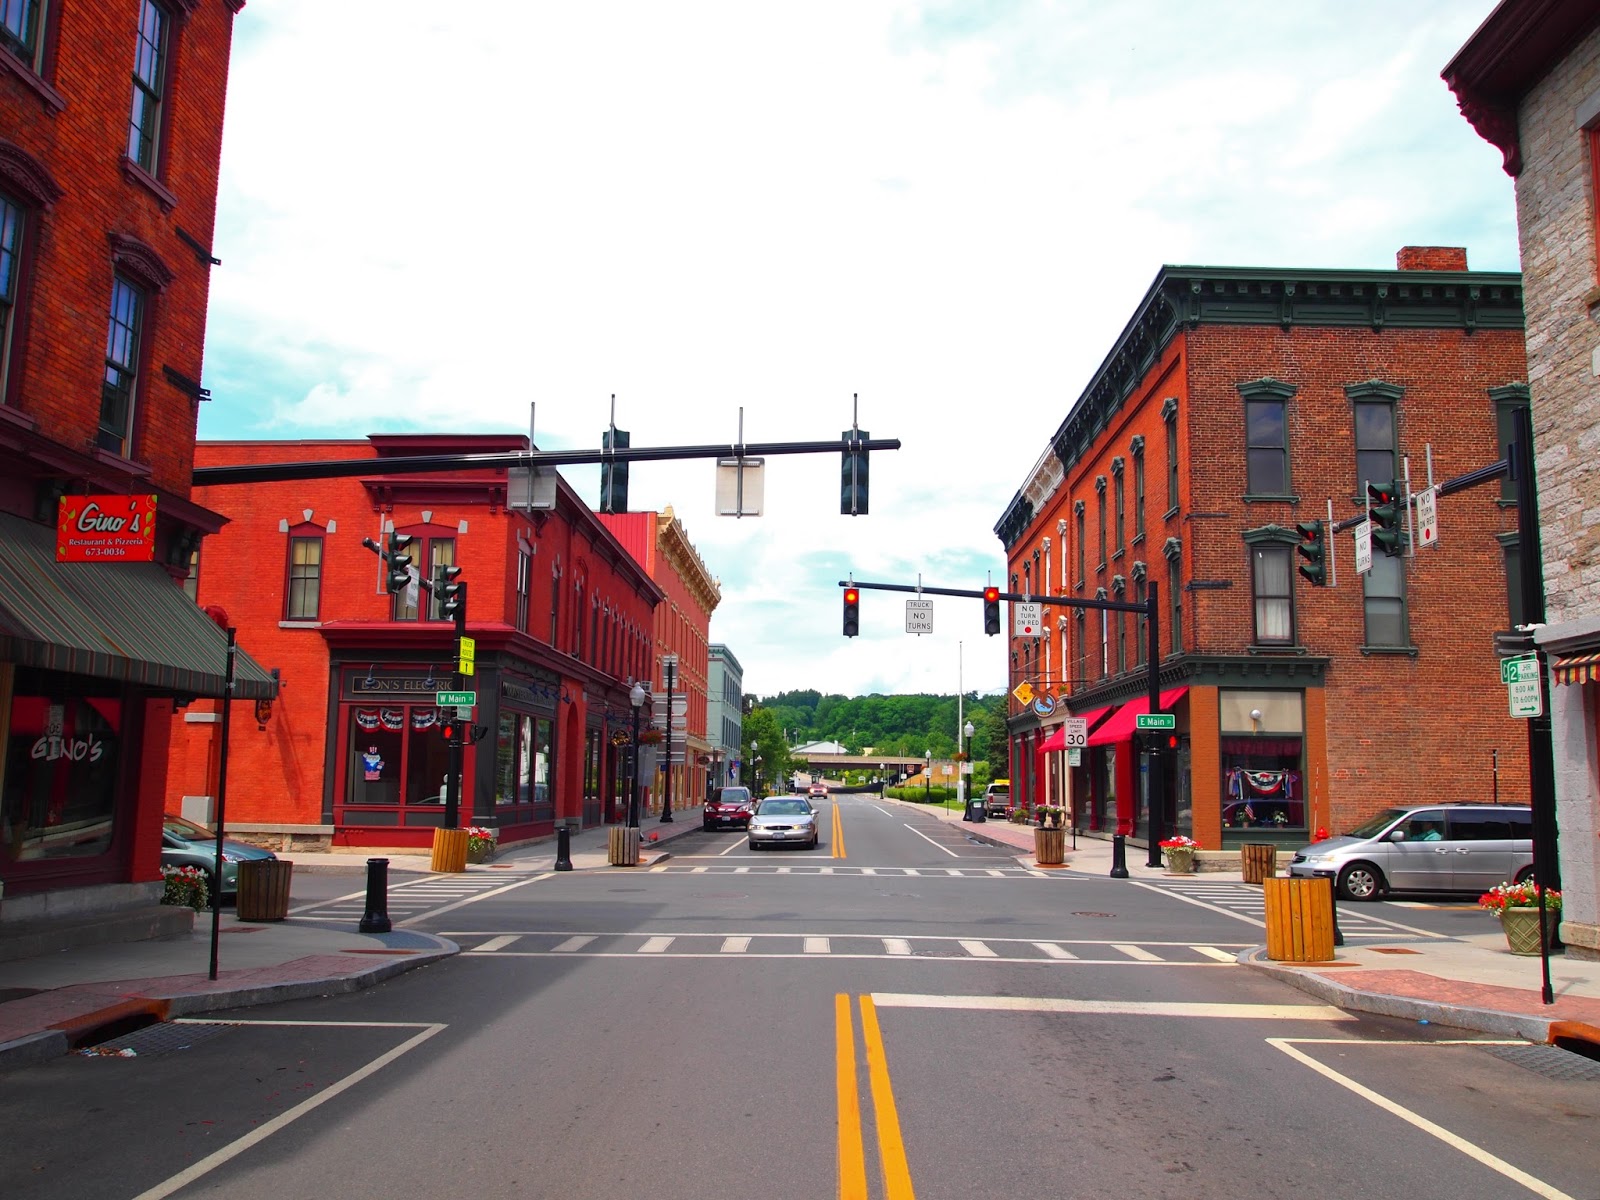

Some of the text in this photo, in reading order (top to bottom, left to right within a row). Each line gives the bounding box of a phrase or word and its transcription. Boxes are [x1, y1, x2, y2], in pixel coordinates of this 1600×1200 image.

[1421, 493, 1431, 506] NO
[77, 501, 140, 532] Gino's
[69, 538, 105, 546] Restaurant
[115, 538, 143, 546] Pizzeria
[85, 548, 125, 556] 673-0036
[913, 612, 926, 620] NO
[908, 622, 931, 630] TURNS
[1510, 666, 1518, 680] 2
[1518, 671, 1539, 681] PARKING
[404, 680, 453, 691] ELECRIC
[1527, 684, 1535, 692] AM
[440, 694, 447, 703] W
[448, 694, 466, 703] Main
[1140, 717, 1145, 726] E
[1147, 717, 1165, 726] Main
[1067, 734, 1085, 745] 30
[32, 732, 104, 762] GINO'S
